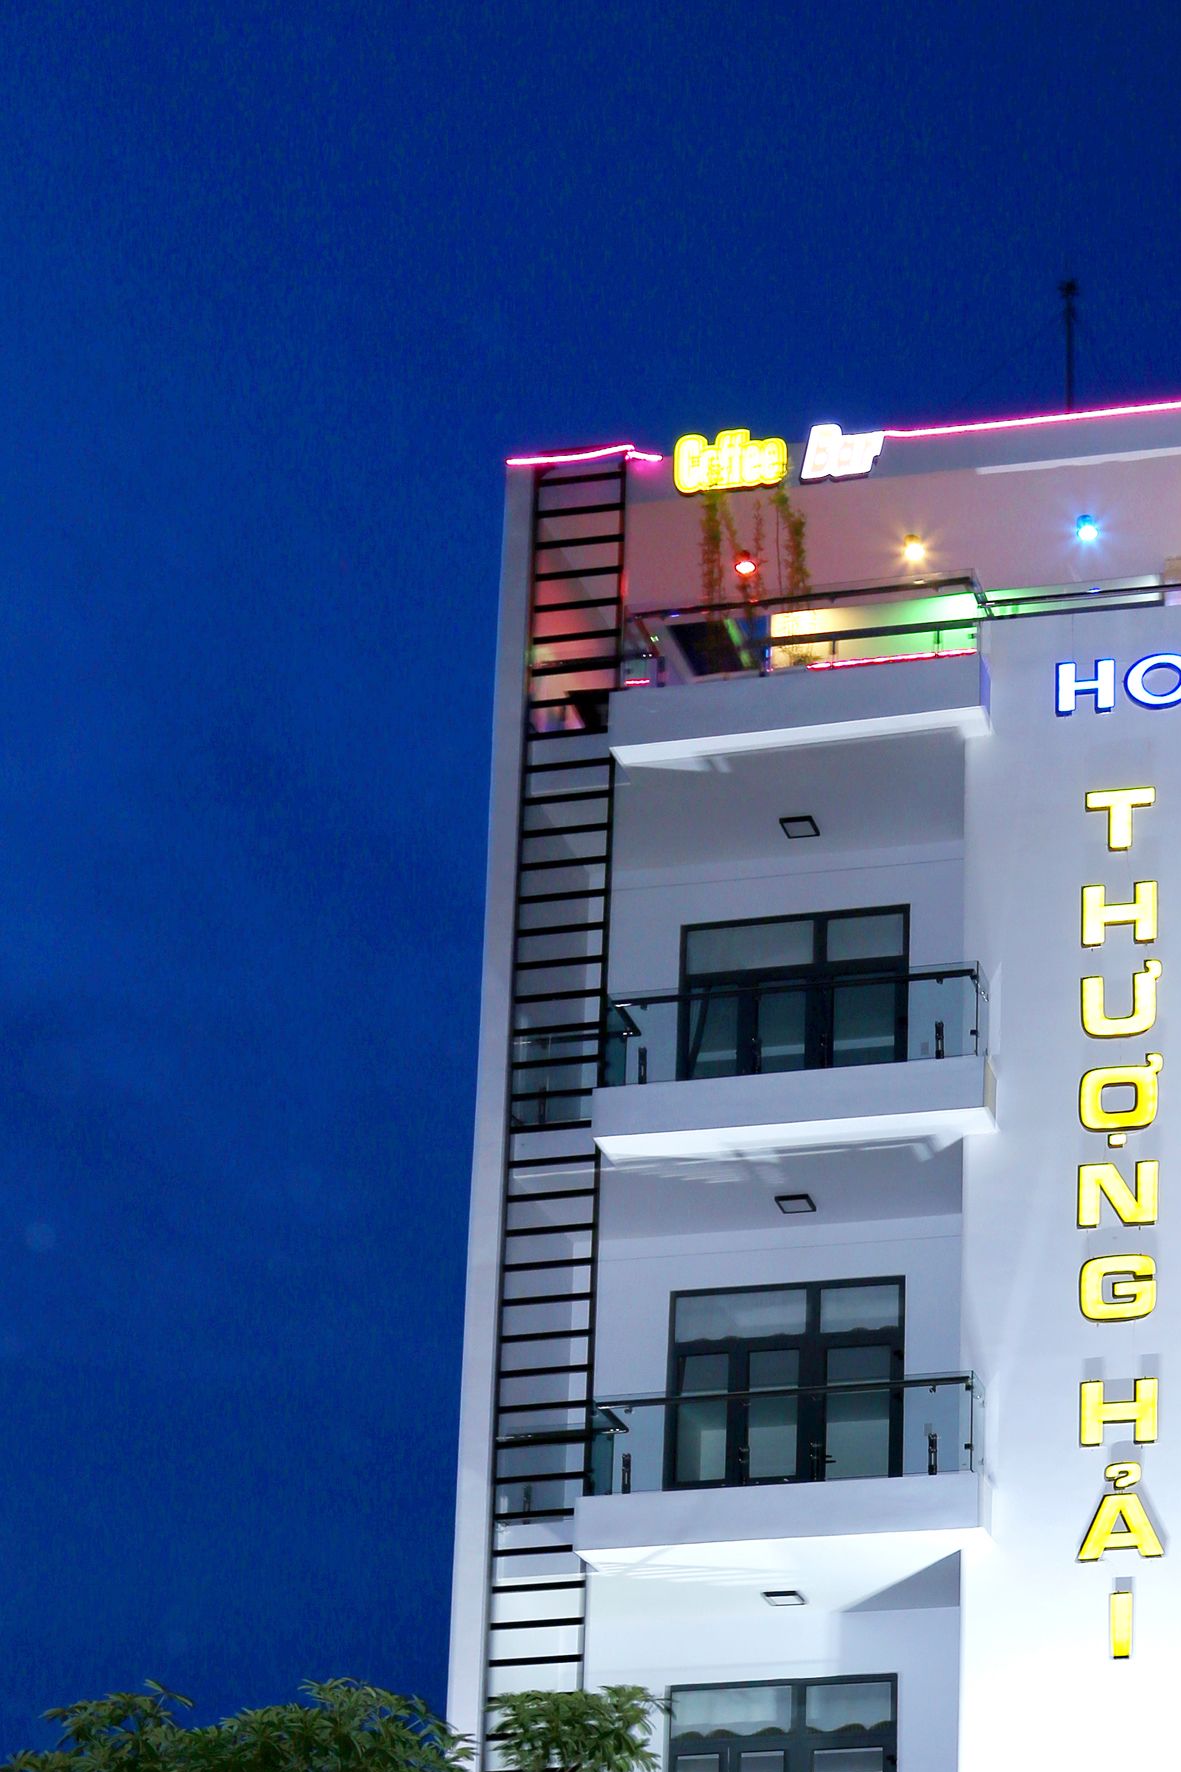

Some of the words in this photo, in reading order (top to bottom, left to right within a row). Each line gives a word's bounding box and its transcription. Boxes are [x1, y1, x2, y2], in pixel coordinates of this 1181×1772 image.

[674, 428, 788, 496] Coffee
[800, 423, 885, 484] Bar
[1077, 786, 1164, 1324] THƯỢNG
[1076, 1376, 1165, 1660] HẢI
